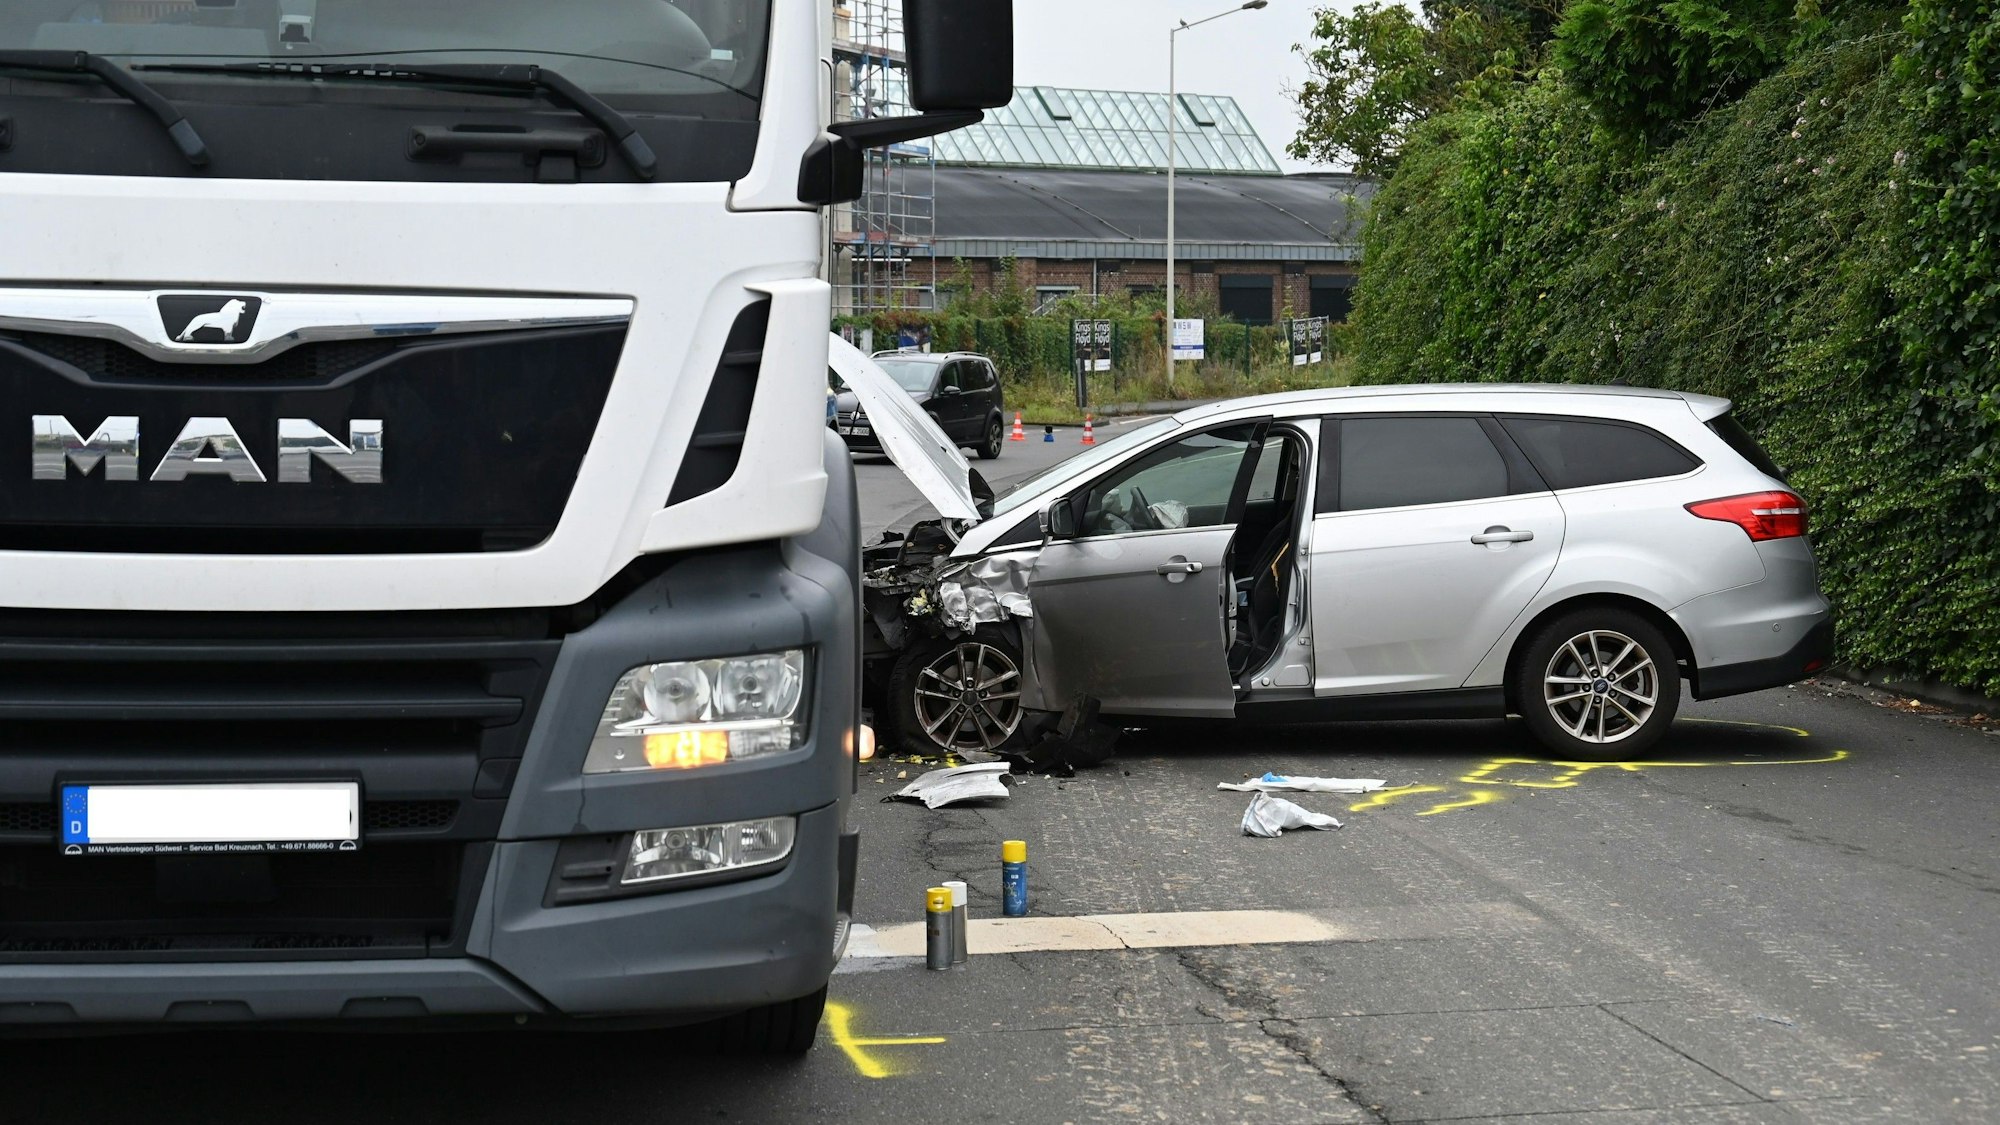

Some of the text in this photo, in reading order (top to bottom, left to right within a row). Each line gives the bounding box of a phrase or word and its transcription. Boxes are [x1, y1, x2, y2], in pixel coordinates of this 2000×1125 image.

[1075, 322, 1091, 335] Kings
[1095, 322, 1110, 335] Kings
[1076, 333, 1091, 346] Floyd
[1095, 333, 1110, 346] Floyd
[32, 414, 383, 483] MAN
[71, 820, 82, 834] D
[87, 845, 104, 853] MAN
[105, 845, 154, 854] Vertriebsregion
[155, 844, 183, 852] Südwest
[189, 843, 213, 852] Service
[214, 843, 228, 851] Bad
